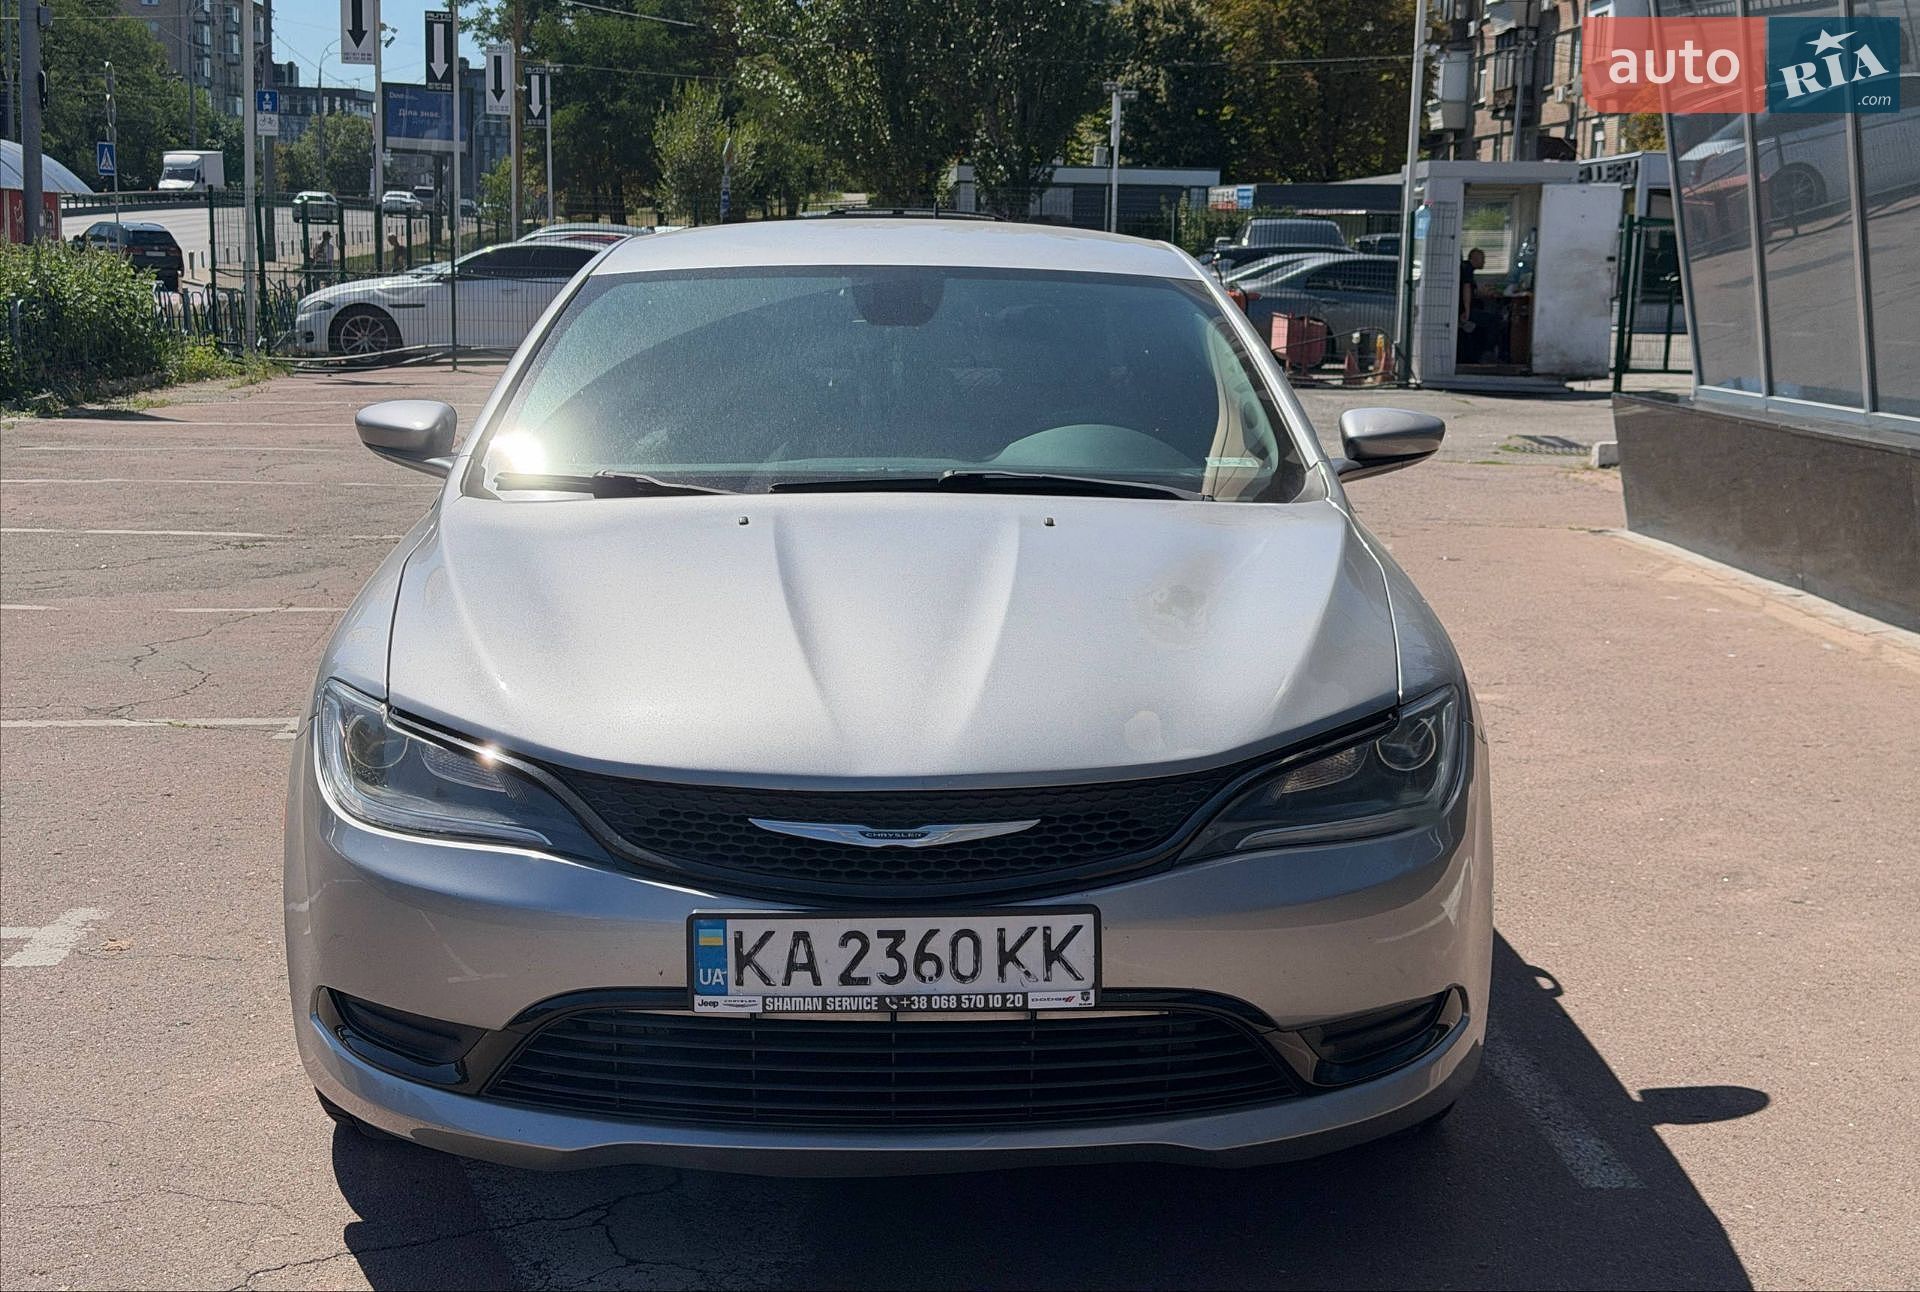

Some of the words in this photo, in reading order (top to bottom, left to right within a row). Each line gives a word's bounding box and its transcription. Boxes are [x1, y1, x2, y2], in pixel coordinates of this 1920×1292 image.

[734, 930, 822, 986] KA
[838, 928, 983, 986] 2360
[996, 925, 1084, 984] KK
[699, 968, 726, 986] UA
[697, 999, 719, 1009] Jeep
[765, 997, 822, 1011] SHAMAN
[826, 996, 878, 1011] SERVICE
[900, 996, 927, 1009] +38
[932, 995, 957, 1009] 068
[961, 994, 984, 1008] 570
[988, 994, 1002, 1008] 10
[1006, 993, 1023, 1007] 20
